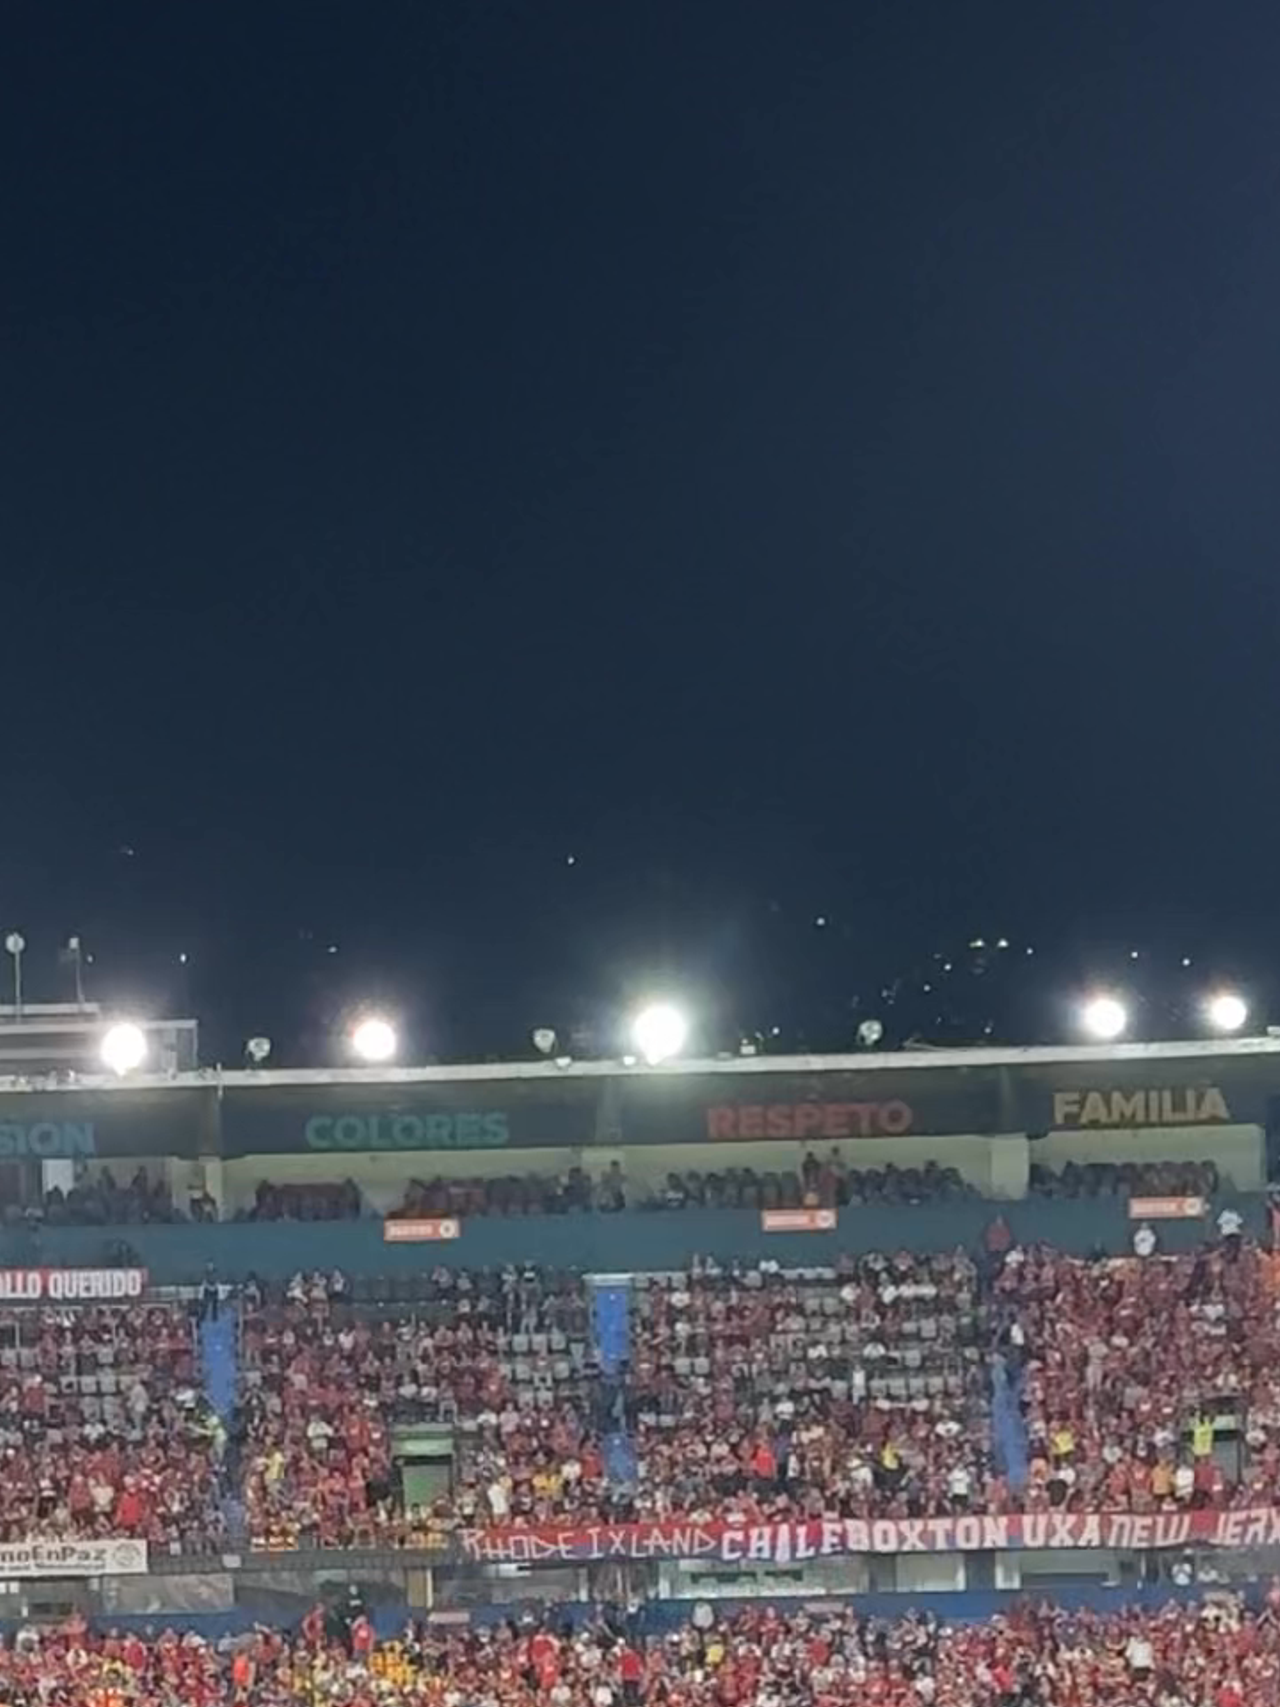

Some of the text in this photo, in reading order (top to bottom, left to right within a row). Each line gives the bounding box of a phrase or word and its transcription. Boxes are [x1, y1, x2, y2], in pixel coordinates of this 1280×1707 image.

[707, 1099, 913, 1138] RESPETO
[1053, 1087, 1229, 1127] FAMILIA
[305, 1112, 510, 1151] COLORES
[48, 1269, 143, 1300] QUERIDO
